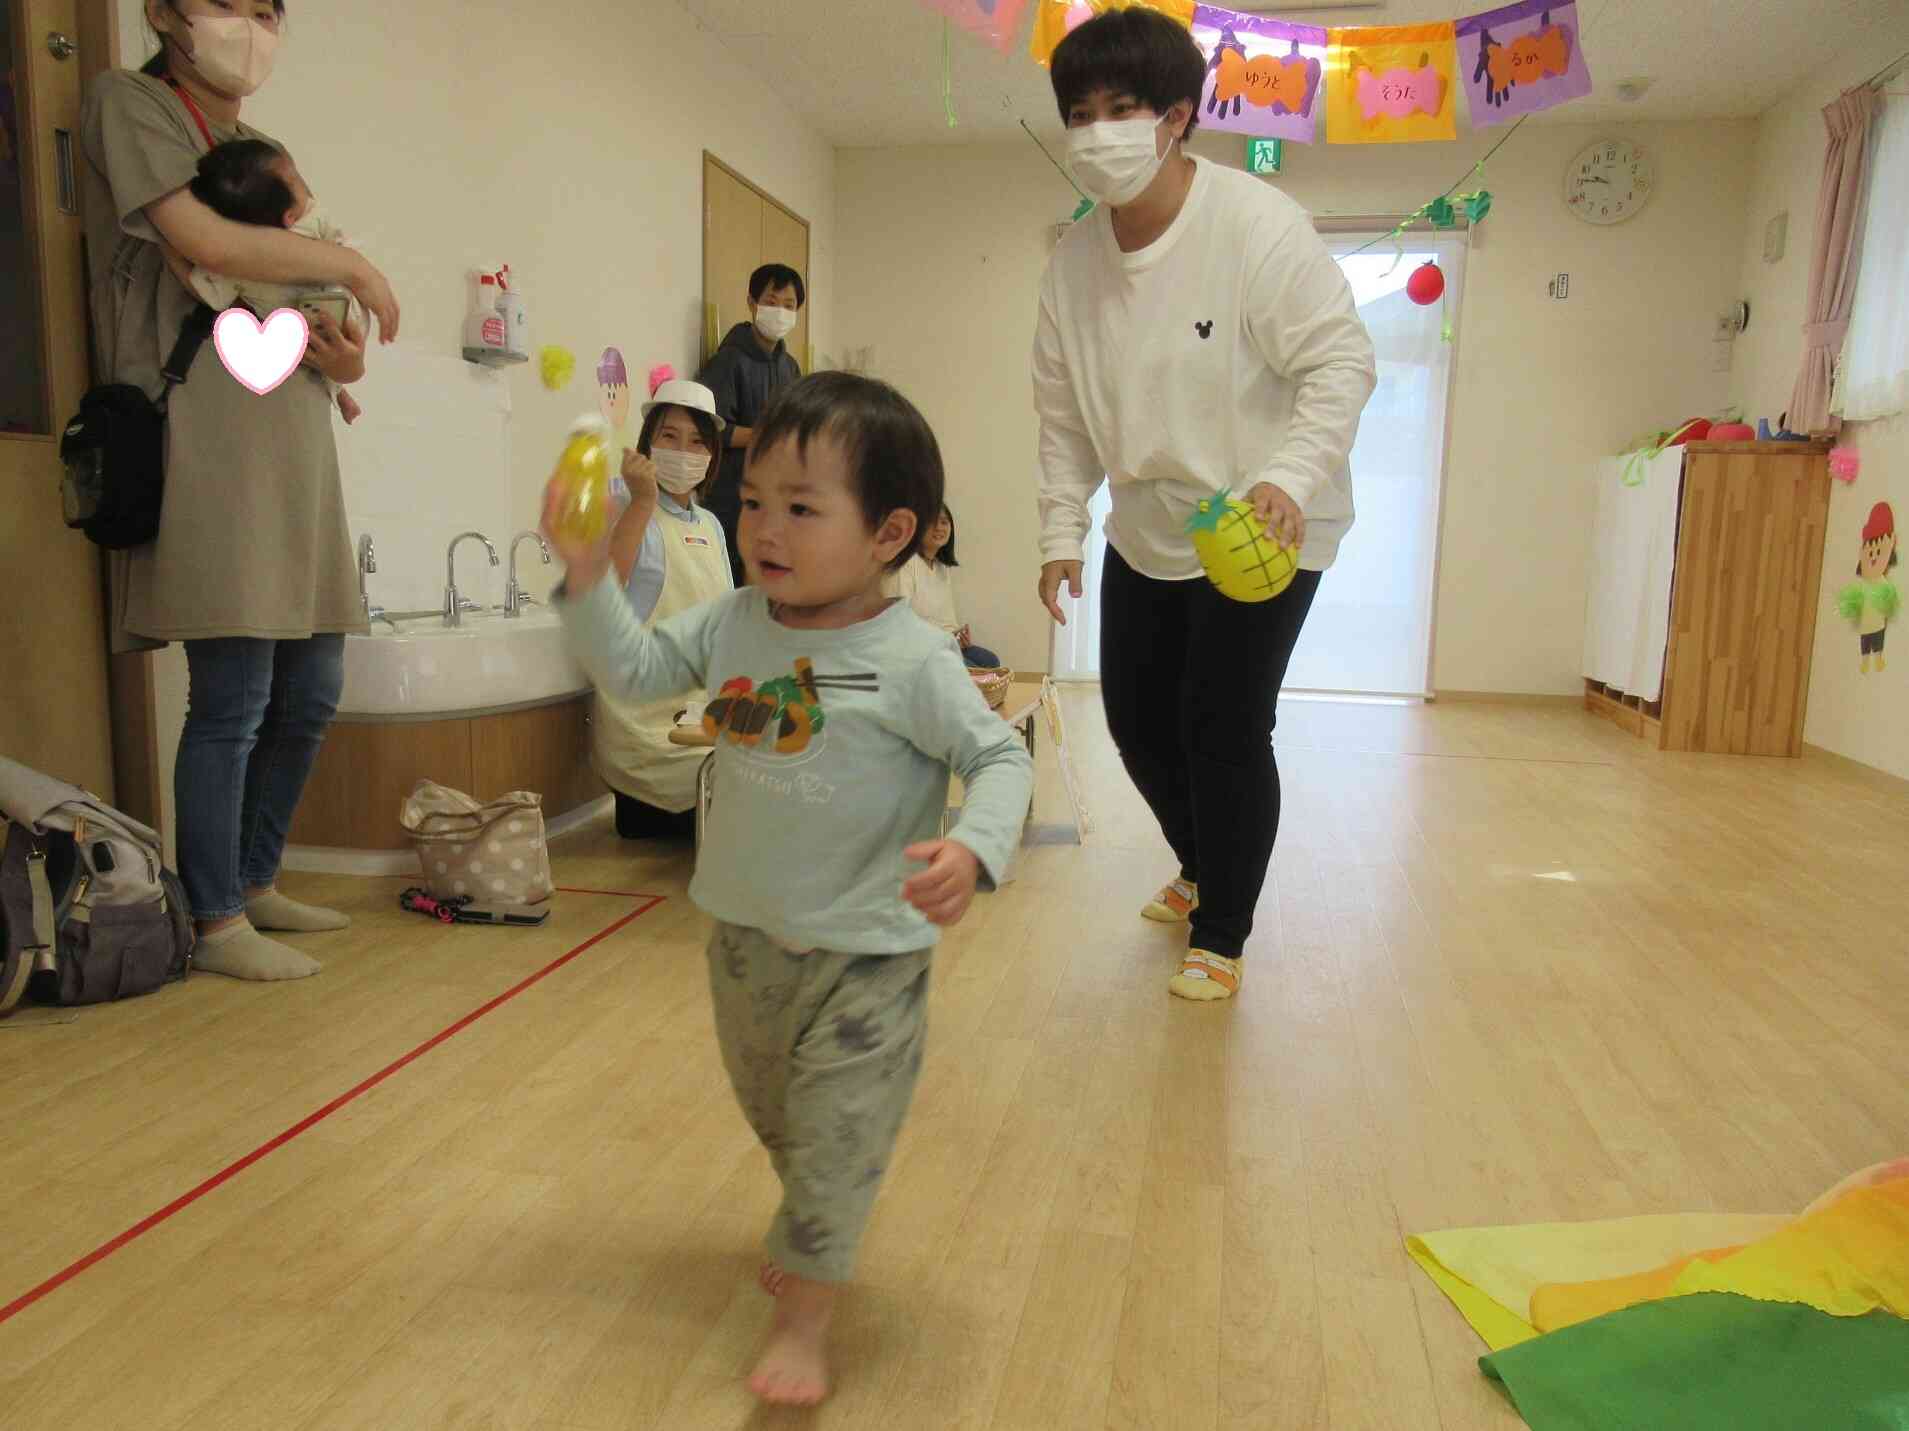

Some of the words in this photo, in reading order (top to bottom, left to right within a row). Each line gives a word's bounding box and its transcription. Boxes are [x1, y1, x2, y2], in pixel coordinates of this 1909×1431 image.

[1511, 52, 1539, 67] るか
[1245, 71, 1281, 90] ゆうと
